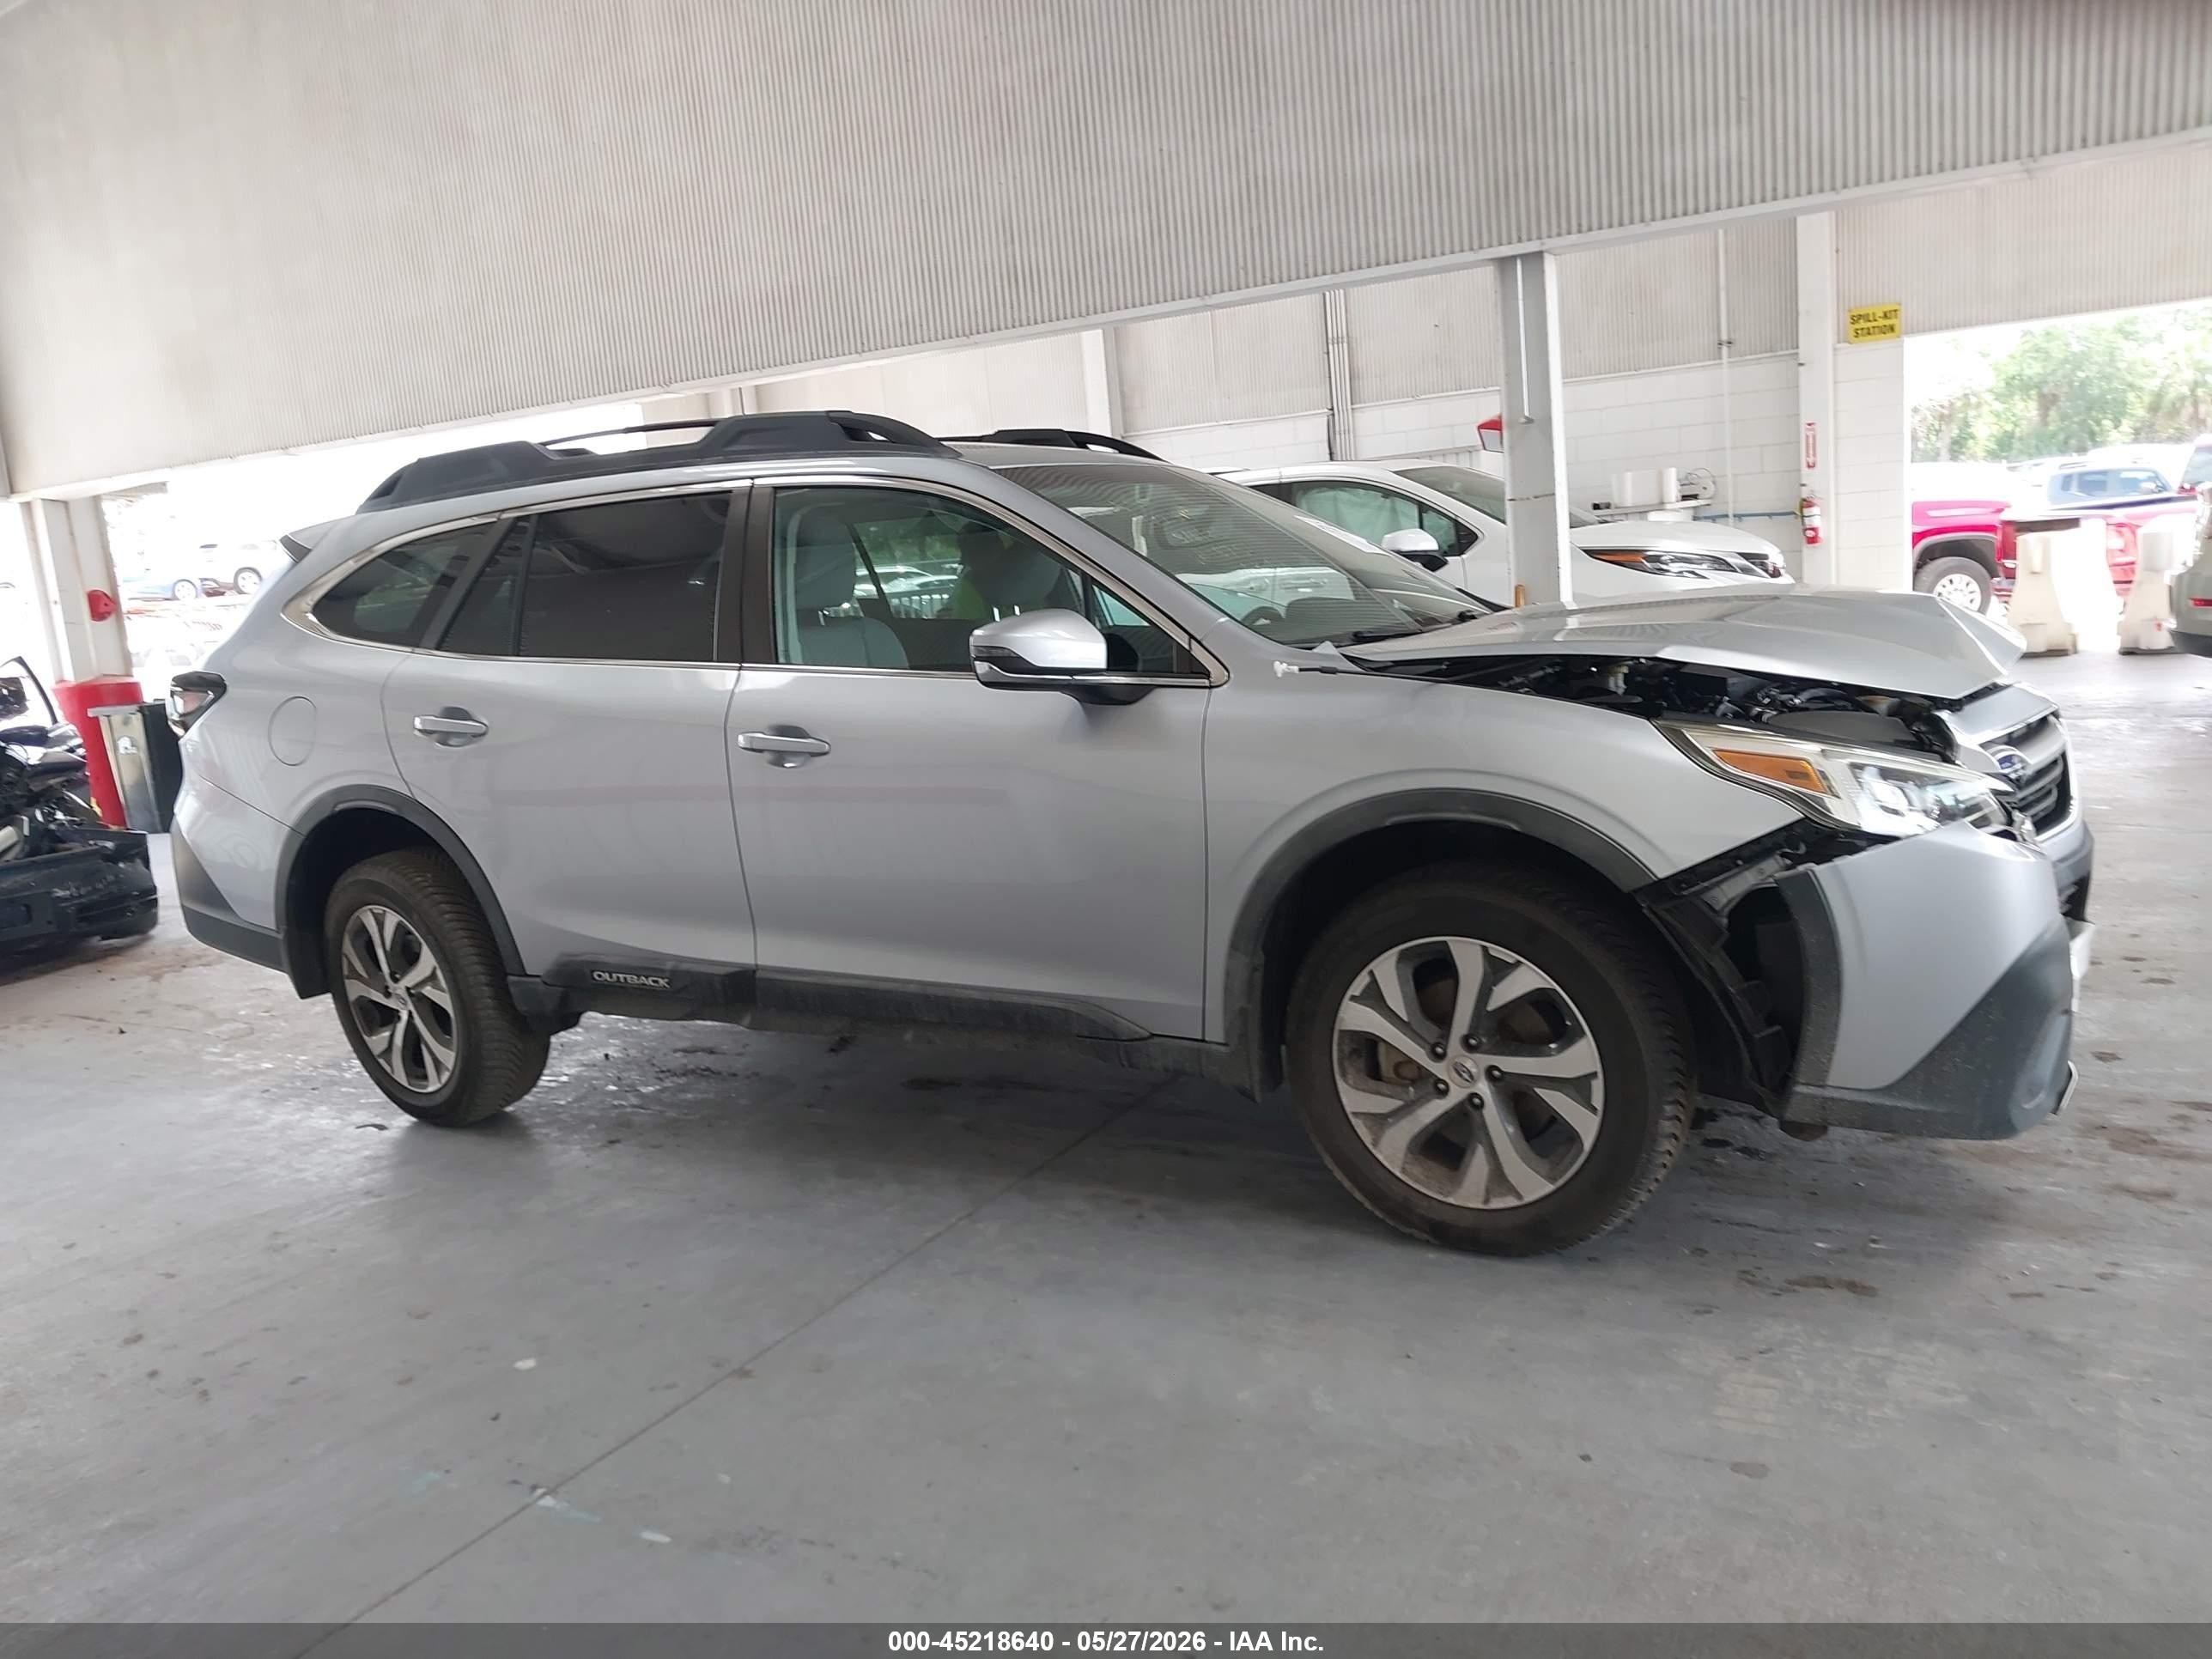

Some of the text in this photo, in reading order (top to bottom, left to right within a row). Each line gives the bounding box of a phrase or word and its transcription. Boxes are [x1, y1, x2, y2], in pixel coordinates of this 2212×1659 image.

[1850, 309, 1899, 325] SPILL-KIT
[1853, 324, 1896, 338] STATION
[592, 969, 671, 988] OUTBACK
